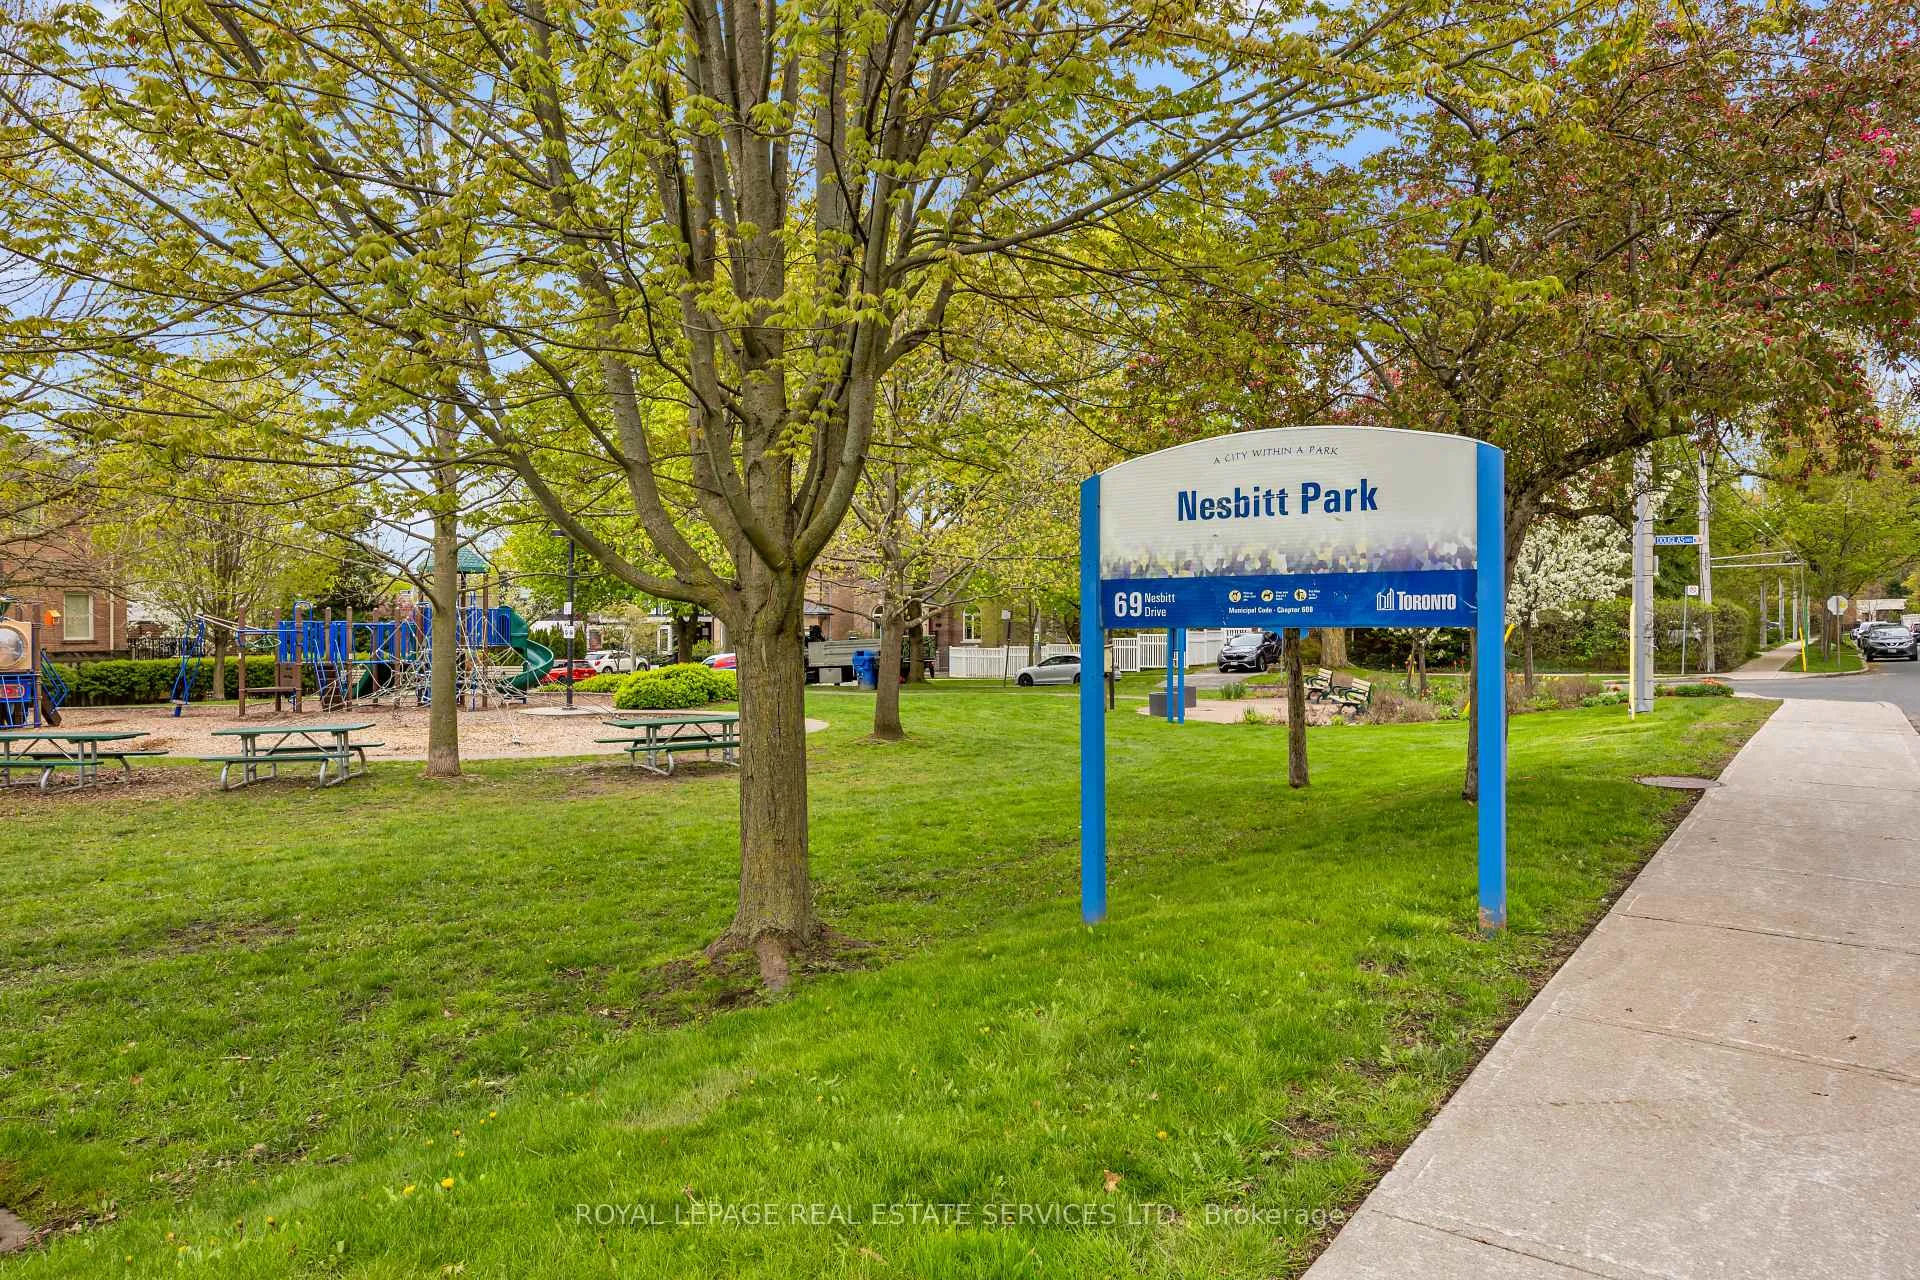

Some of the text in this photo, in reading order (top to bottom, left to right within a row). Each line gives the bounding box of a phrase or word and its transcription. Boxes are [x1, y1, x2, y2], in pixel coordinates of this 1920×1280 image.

[1213, 445, 1339, 464] A CITY WITHIN A PARK
[1177, 478, 1378, 521] Nesbitt Park
[1114, 591, 1142, 617] 69
[1144, 592, 1176, 604] Nesbitt
[1396, 591, 1457, 611] TORONTO
[1144, 606, 1167, 617] Drive
[1228, 606, 1257, 615] Municipal
[1258, 606, 1273, 614] Code
[1276, 606, 1301, 615] Chapter
